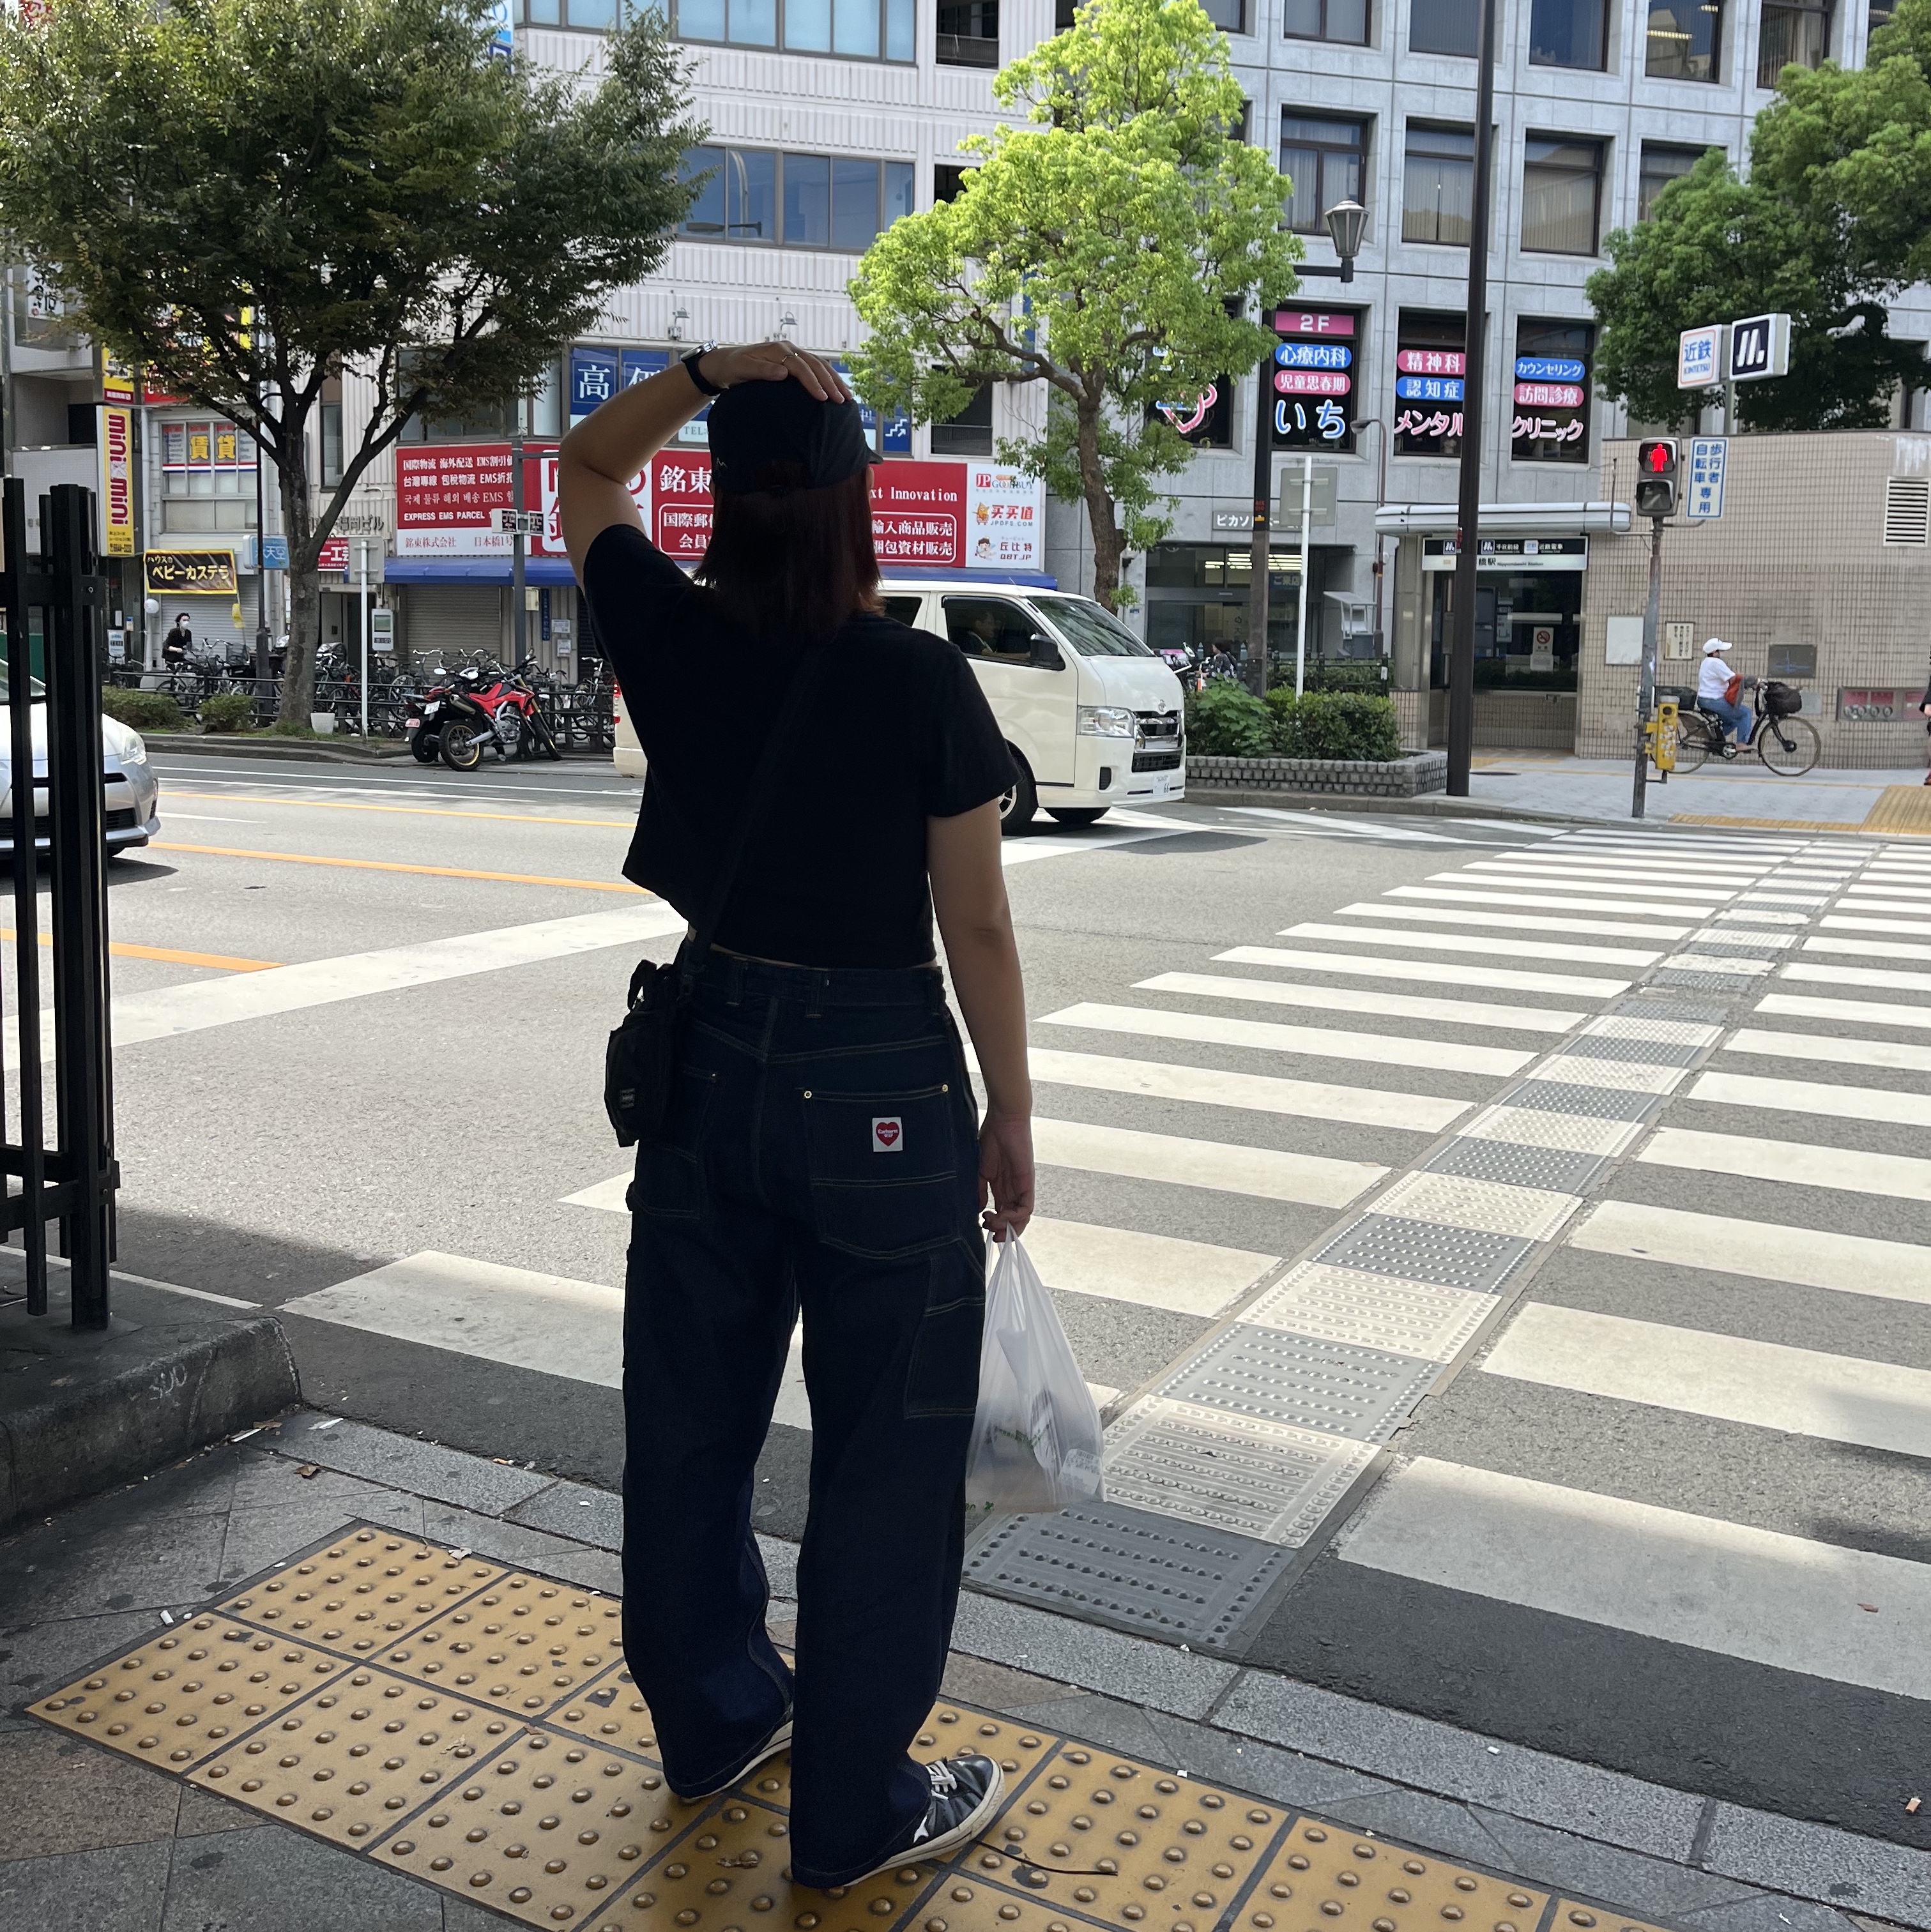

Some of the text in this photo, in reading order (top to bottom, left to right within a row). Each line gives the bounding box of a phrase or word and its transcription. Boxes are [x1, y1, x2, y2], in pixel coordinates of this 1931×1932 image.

[1300, 314, 1330, 332] 2F
[1280, 346, 1347, 367] 心療内科
[1684, 339, 1711, 362] 近鉄
[1407, 351, 1460, 372] 精神科
[1517, 361, 1582, 377] カウンセリング
[1684, 363, 1711, 374] KINTETSU
[1280, 374, 1345, 392] 児童思春期
[1407, 379, 1460, 399] 認知症
[1519, 384, 1578, 405] 訪問診療
[1275, 399, 1345, 439] いち
[1394, 409, 1463, 437] メンタル
[109, 414, 126, 462] mini
[1512, 416, 1584, 442] クリニック
[190, 435, 236, 459] 賃貸
[403, 458, 436, 471] 国際物流
[439, 457, 473, 469] 海外配送
[1695, 443, 1707, 483] 自転車
[1709, 443, 1722, 483] 歩行者
[659, 464, 712, 494] 銘東
[977, 474, 991, 487] JP
[111, 478, 128, 525] mini
[404, 493, 420, 505] 국제
[443, 492, 460, 504] 해외
[483, 492, 503, 503] EMS
[890, 487, 958, 501] Innovation
[1700, 487, 1711, 513] 専用
[404, 511, 485, 521] EXPRESS EMS PARCEL
[991, 505, 1034, 520] 买买值
[872, 519, 952, 536] 輸入商品販売
[406, 536, 456, 548] 銘東株式会社
[679, 533, 712, 549] 会員
[1000, 542, 1032, 552] 丘比特
[152, 565, 229, 580] ベビーカステラ
